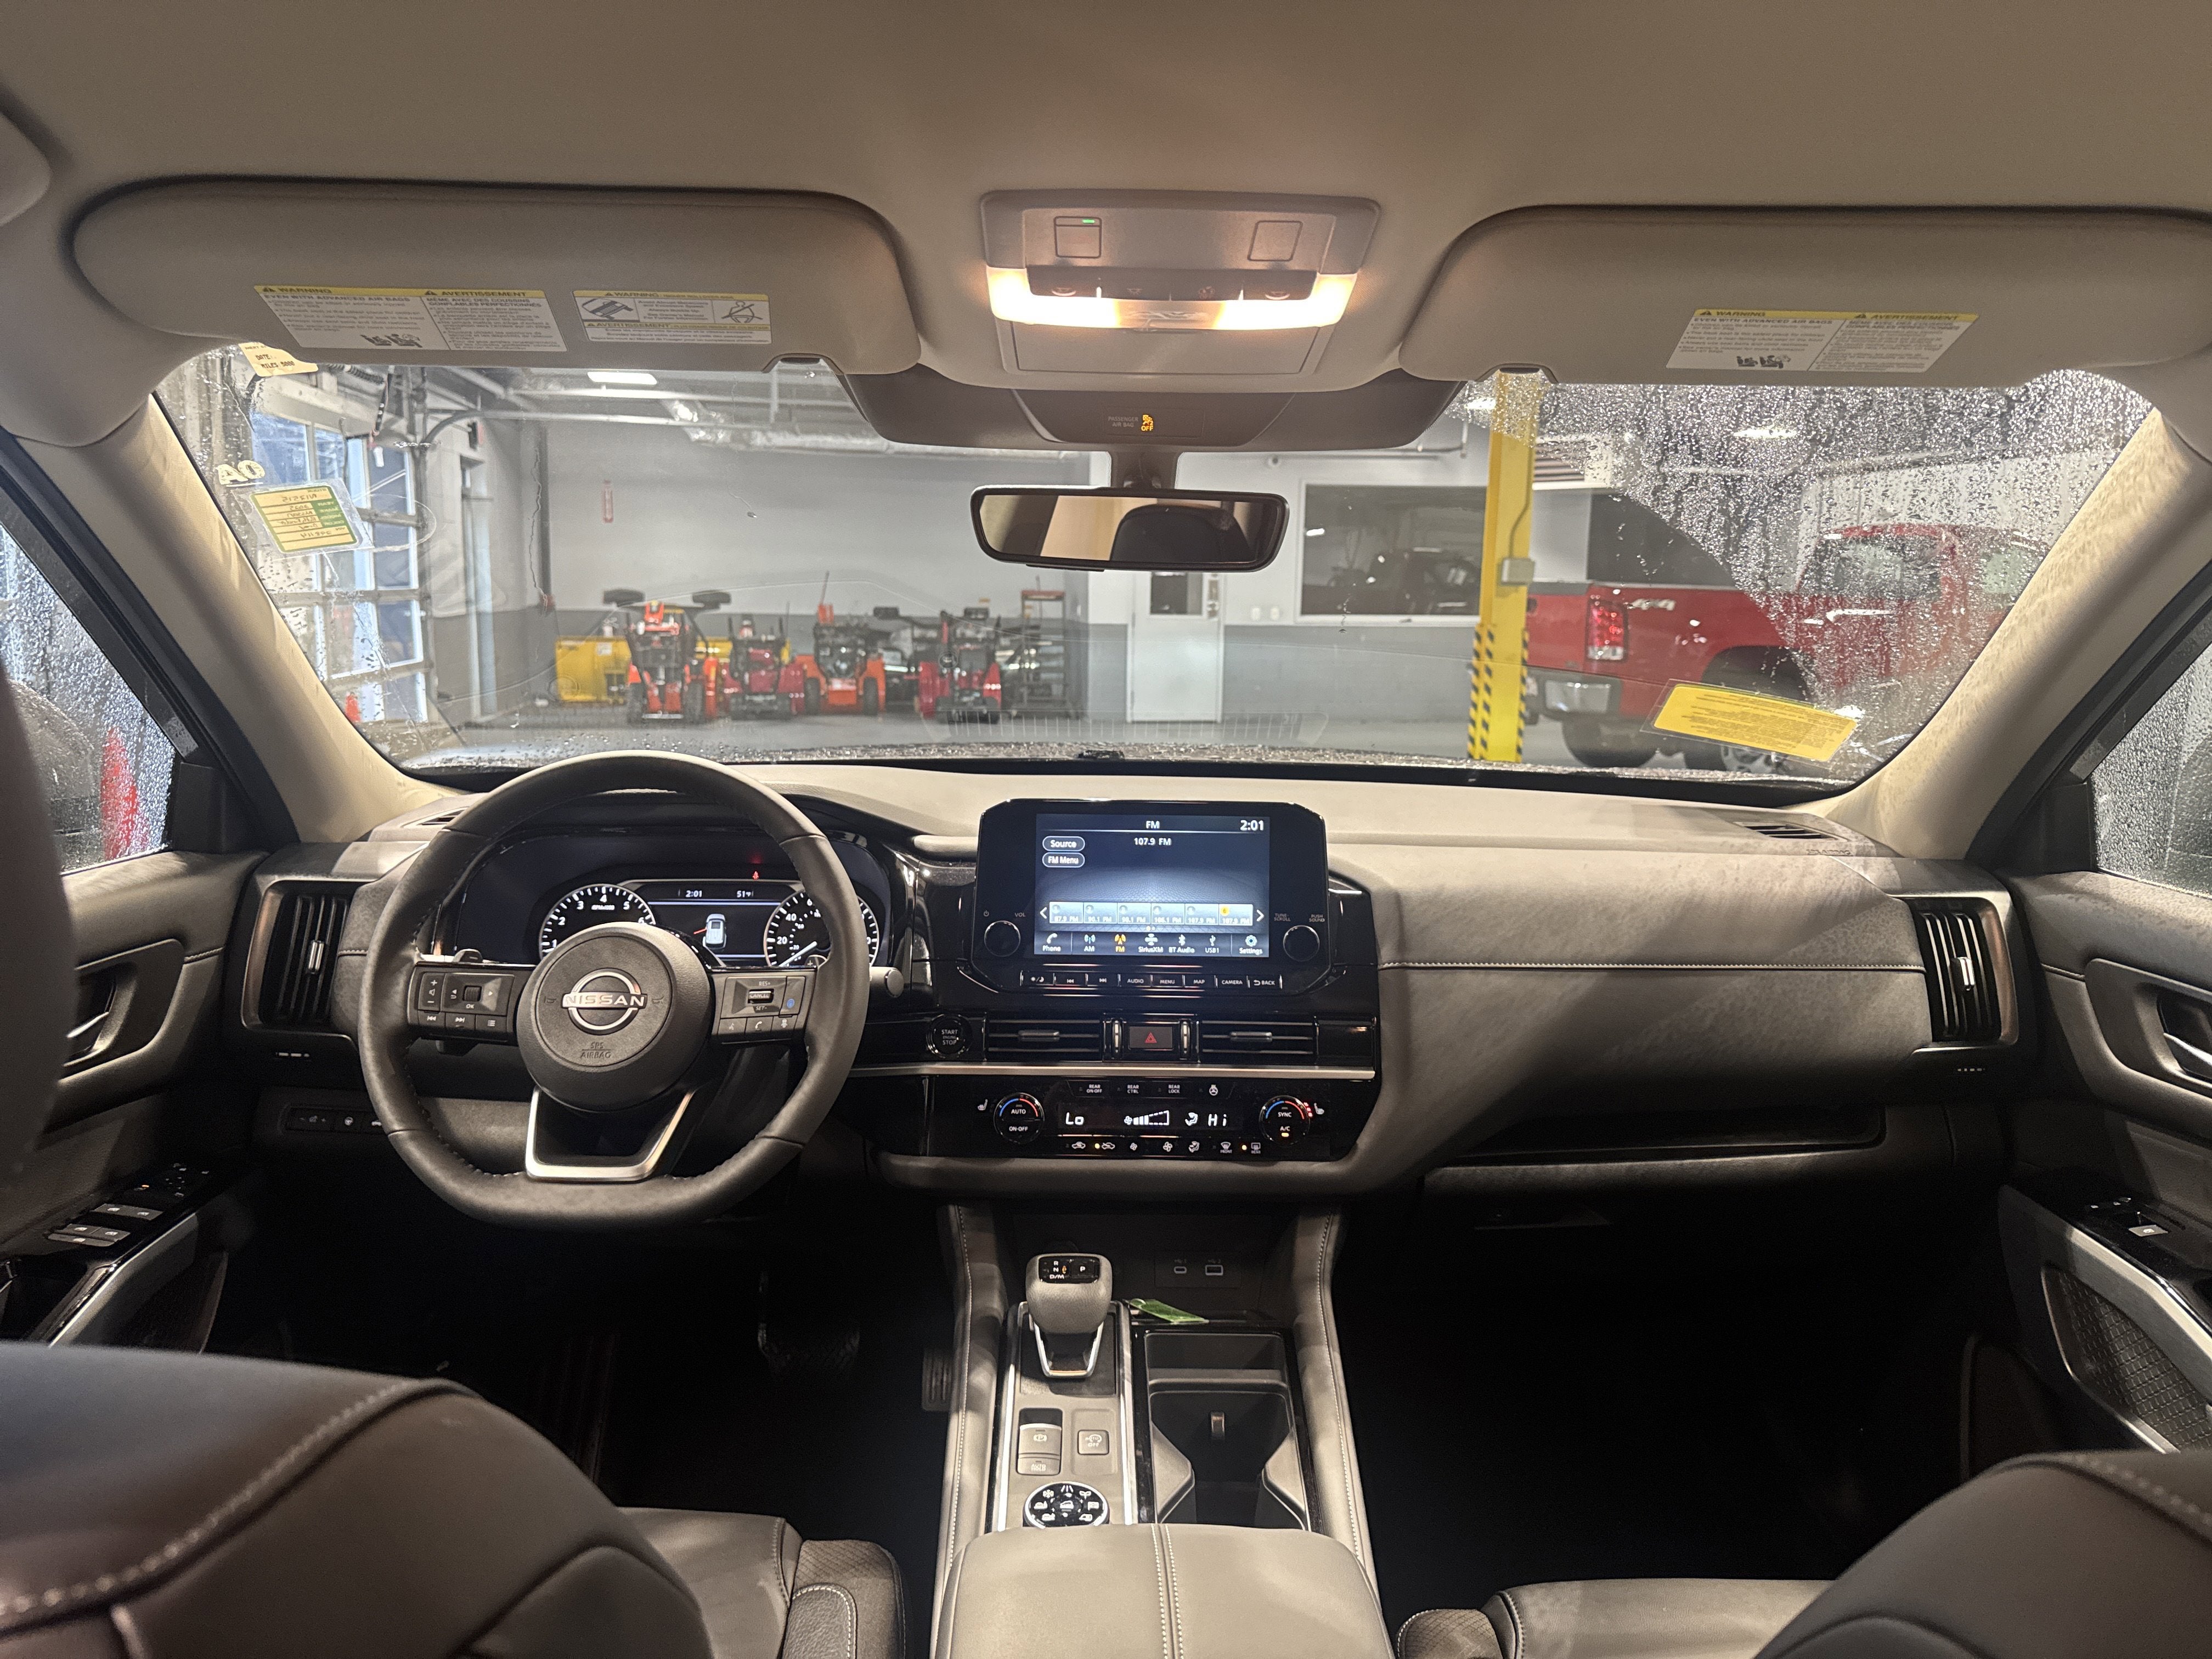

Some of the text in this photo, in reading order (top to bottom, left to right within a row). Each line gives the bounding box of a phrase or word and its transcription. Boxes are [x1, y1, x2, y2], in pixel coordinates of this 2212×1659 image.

[1146, 820, 1161, 830] FM
[1240, 820, 1265, 831] 2:01
[1050, 839, 1077, 849] Source
[1133, 837, 1172, 846] 107.9 FM
[1047, 856, 1079, 865] FM Menu
[599, 894, 607, 903] 4
[576, 900, 584, 910] 3
[623, 901, 630, 910] 5
[557, 916, 566, 926] 2
[785, 913, 797, 921] 40
[552, 939, 557, 948] 1
[776, 936, 788, 945] 20
[1238, 947, 1263, 956] Settings
[566, 994, 645, 1007] NISSAN
[1065, 1112, 1084, 1125] Lo
[1207, 1113, 1227, 1127] Hi
